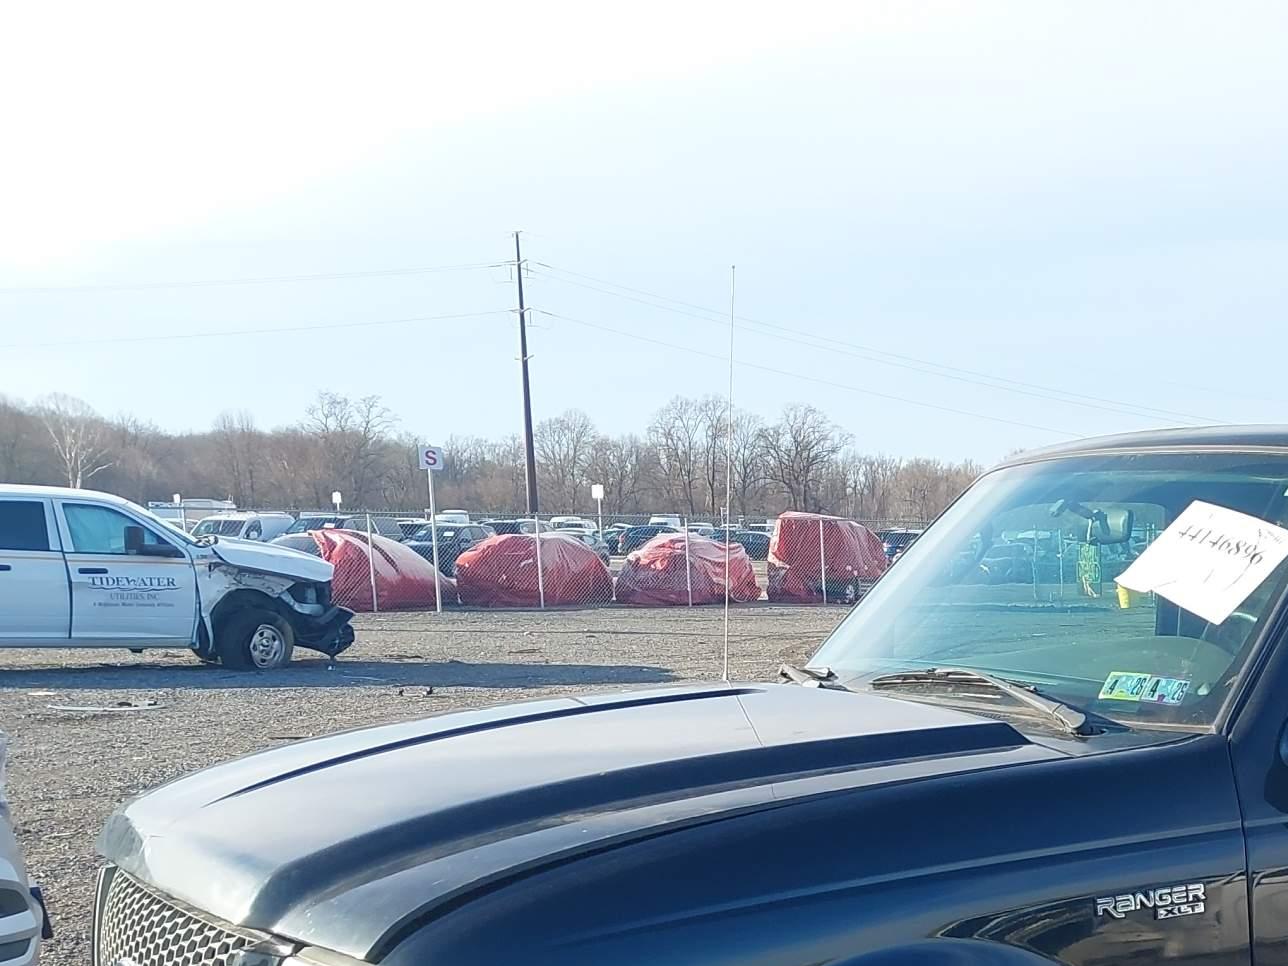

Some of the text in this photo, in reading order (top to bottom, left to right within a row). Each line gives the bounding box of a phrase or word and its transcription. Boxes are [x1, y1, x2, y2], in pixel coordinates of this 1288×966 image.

[424, 449, 437, 466] S
[1178, 525, 1264, 565] 44146896
[87, 576, 177, 587] TIDEWATER
[1096, 883, 1206, 918] RANGER
[1158, 902, 1205, 919] XLT
